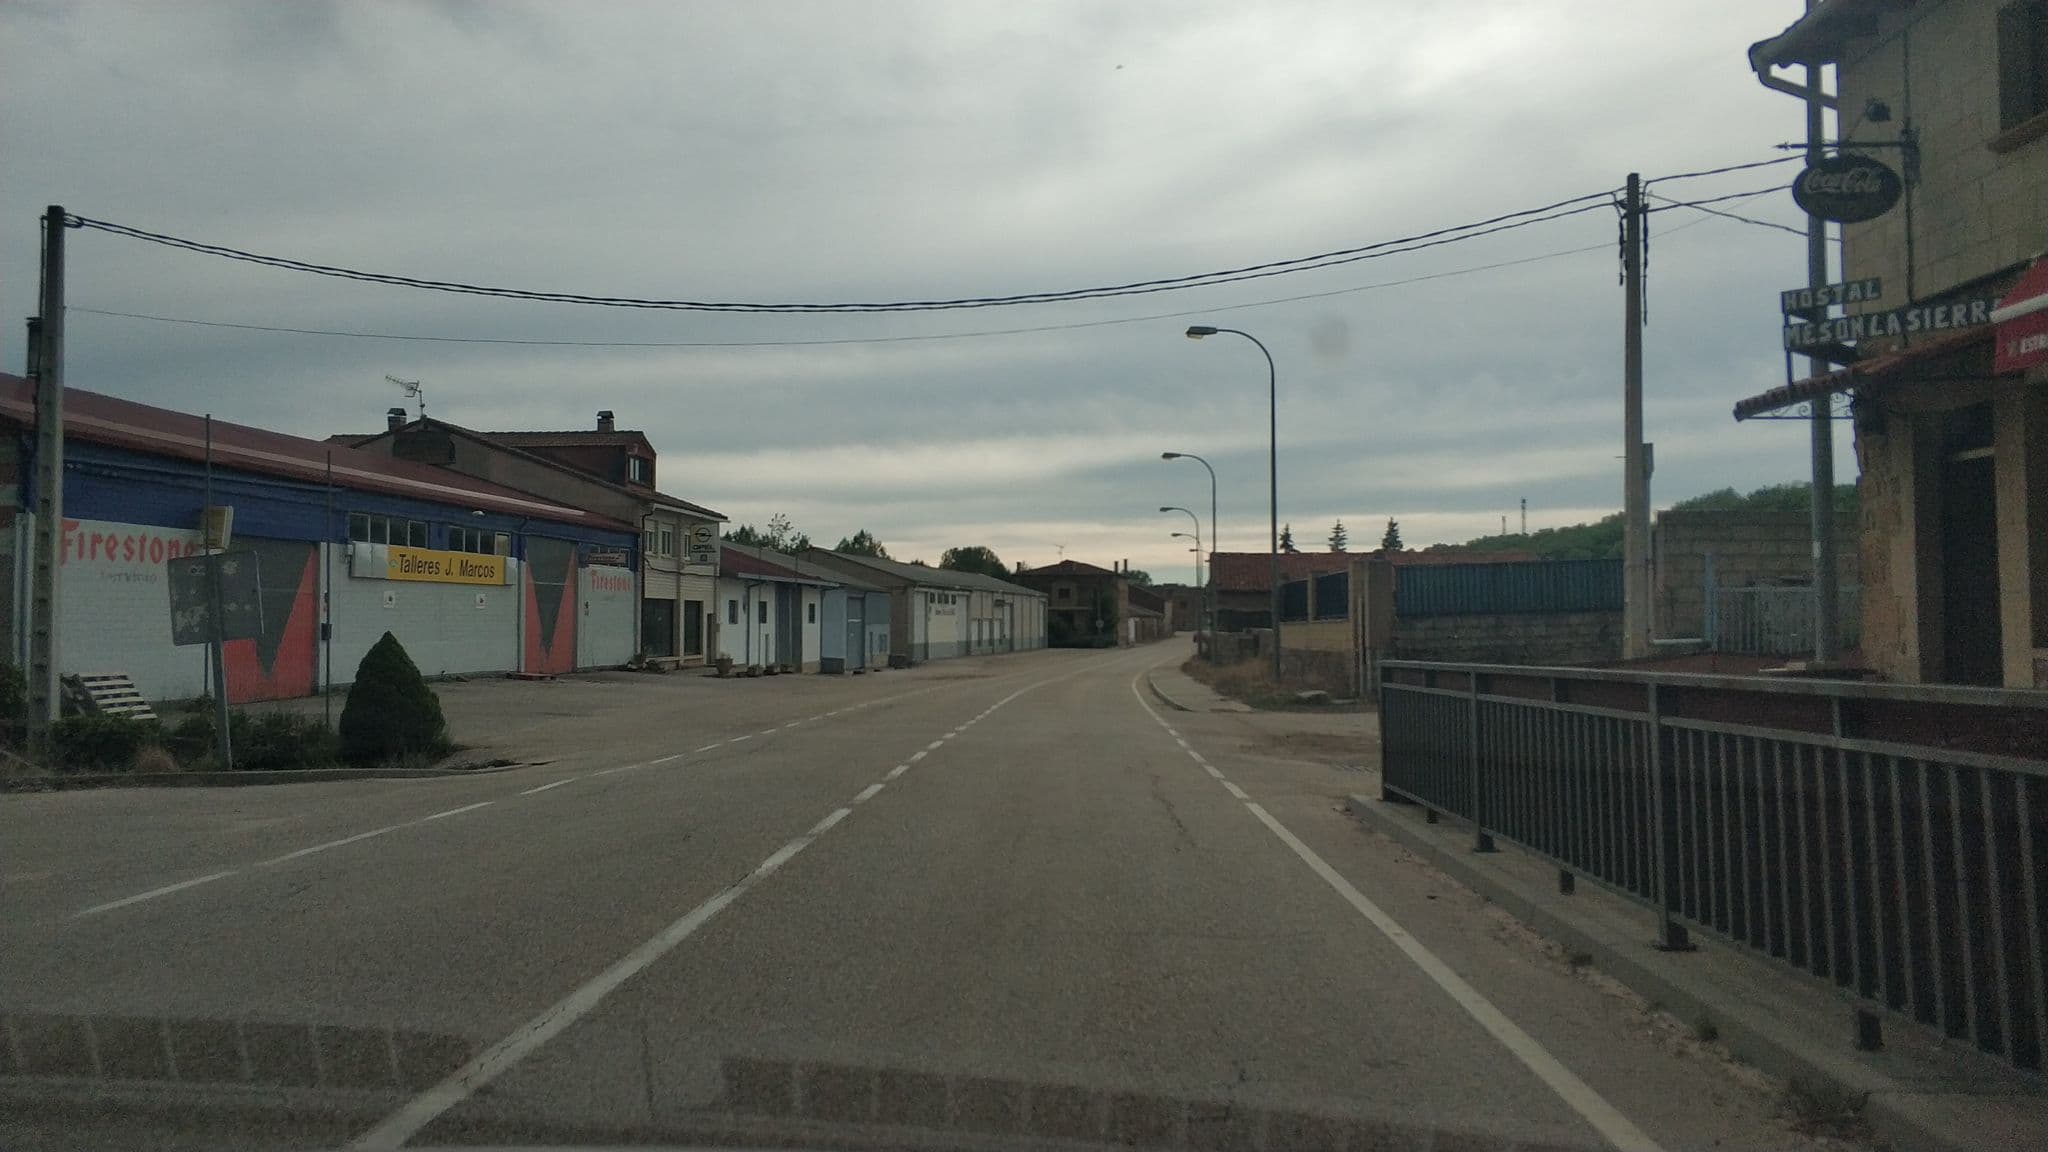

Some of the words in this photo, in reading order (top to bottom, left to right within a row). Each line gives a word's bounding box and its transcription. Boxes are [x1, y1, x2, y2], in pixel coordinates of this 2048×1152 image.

[1785, 280, 1879, 310] HOSTAL
[1787, 315, 1865, 347] MESON
[1869, 312, 1902, 337] LA
[398, 553, 441, 576] Talleres
[445, 557, 455, 577] J.
[459, 559, 495, 579] Marcos
